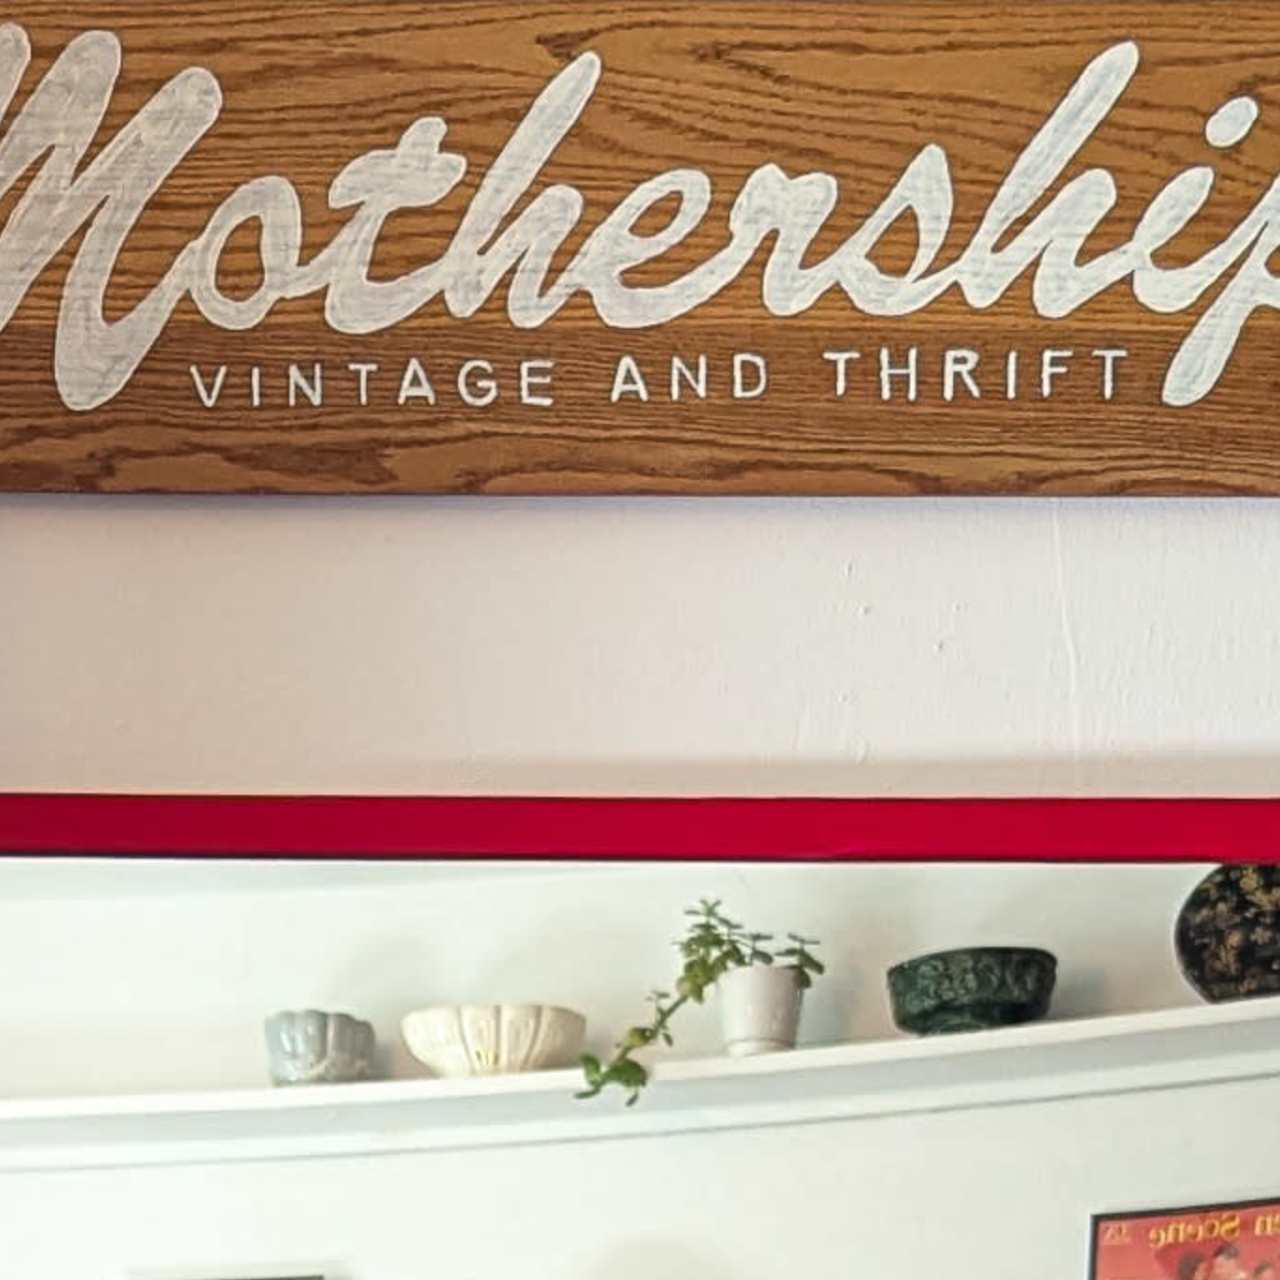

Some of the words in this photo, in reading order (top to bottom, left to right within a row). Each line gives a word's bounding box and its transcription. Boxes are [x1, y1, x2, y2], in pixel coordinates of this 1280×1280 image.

[190, 357, 556, 408] VINTAGE
[610, 350, 769, 402] AND
[823, 347, 1132, 401] THRIFT
